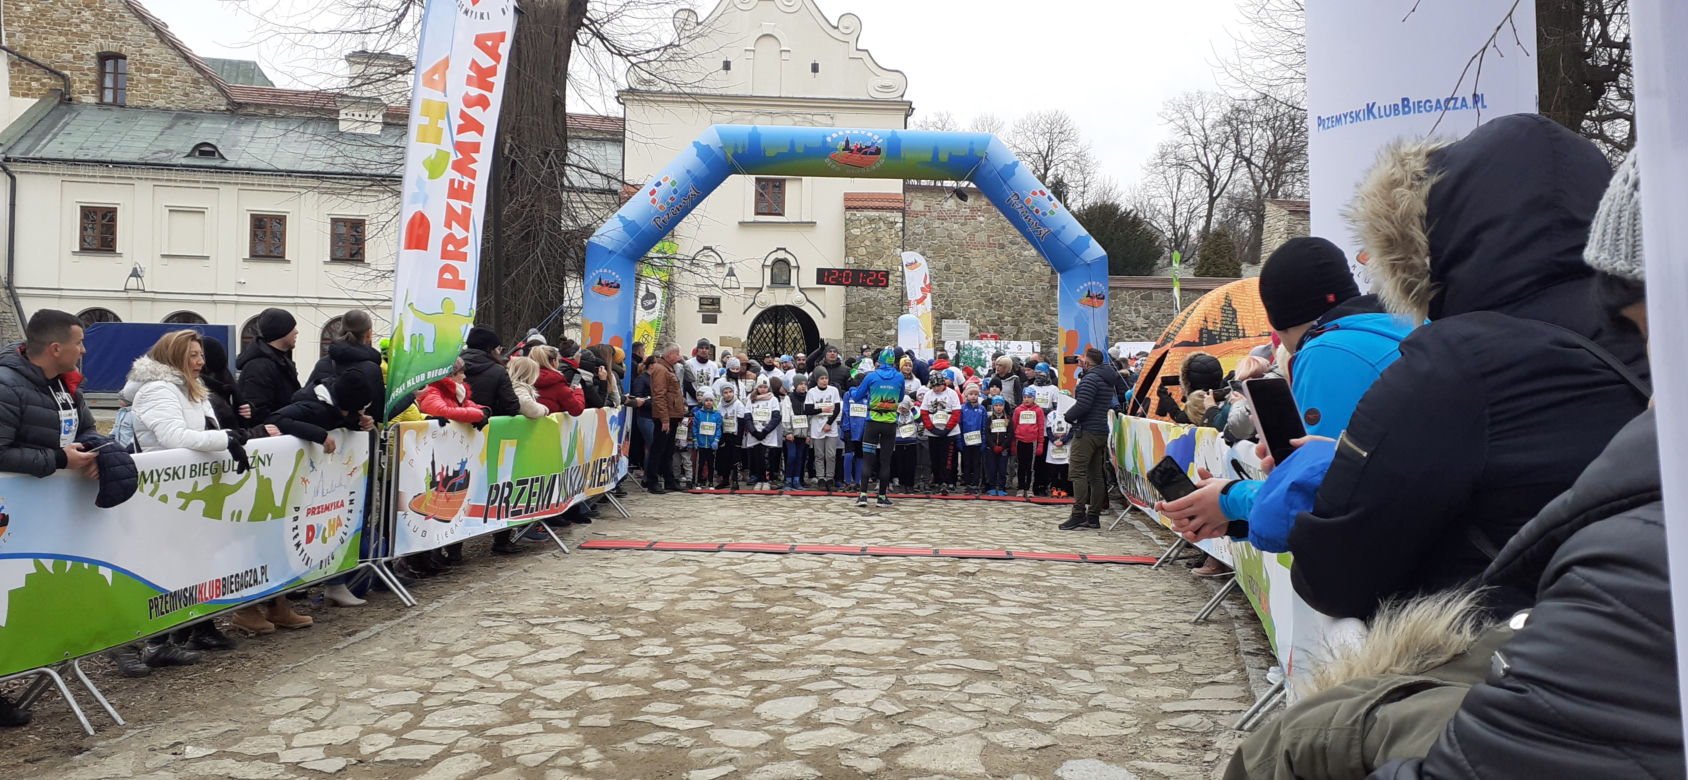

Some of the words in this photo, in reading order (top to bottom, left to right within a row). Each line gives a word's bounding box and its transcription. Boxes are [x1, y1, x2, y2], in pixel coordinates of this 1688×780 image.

[437, 31, 507, 291] PRZEMYSKA
[823, 269, 887, 286] 12:01:25
[138, 465, 186, 485] MYSKI
[189, 460, 219, 478] BIEG
[222, 453, 273, 473] ULZNY
[306, 499, 345, 517] PRZEMYSKA
[292, 506, 313, 568] PRZEMYSKI
[319, 552, 335, 570] BIEG
[305, 514, 343, 545] DYCHA
[148, 564, 269, 620] PRZEMYSKIKLUBBIEGACZA.PL
